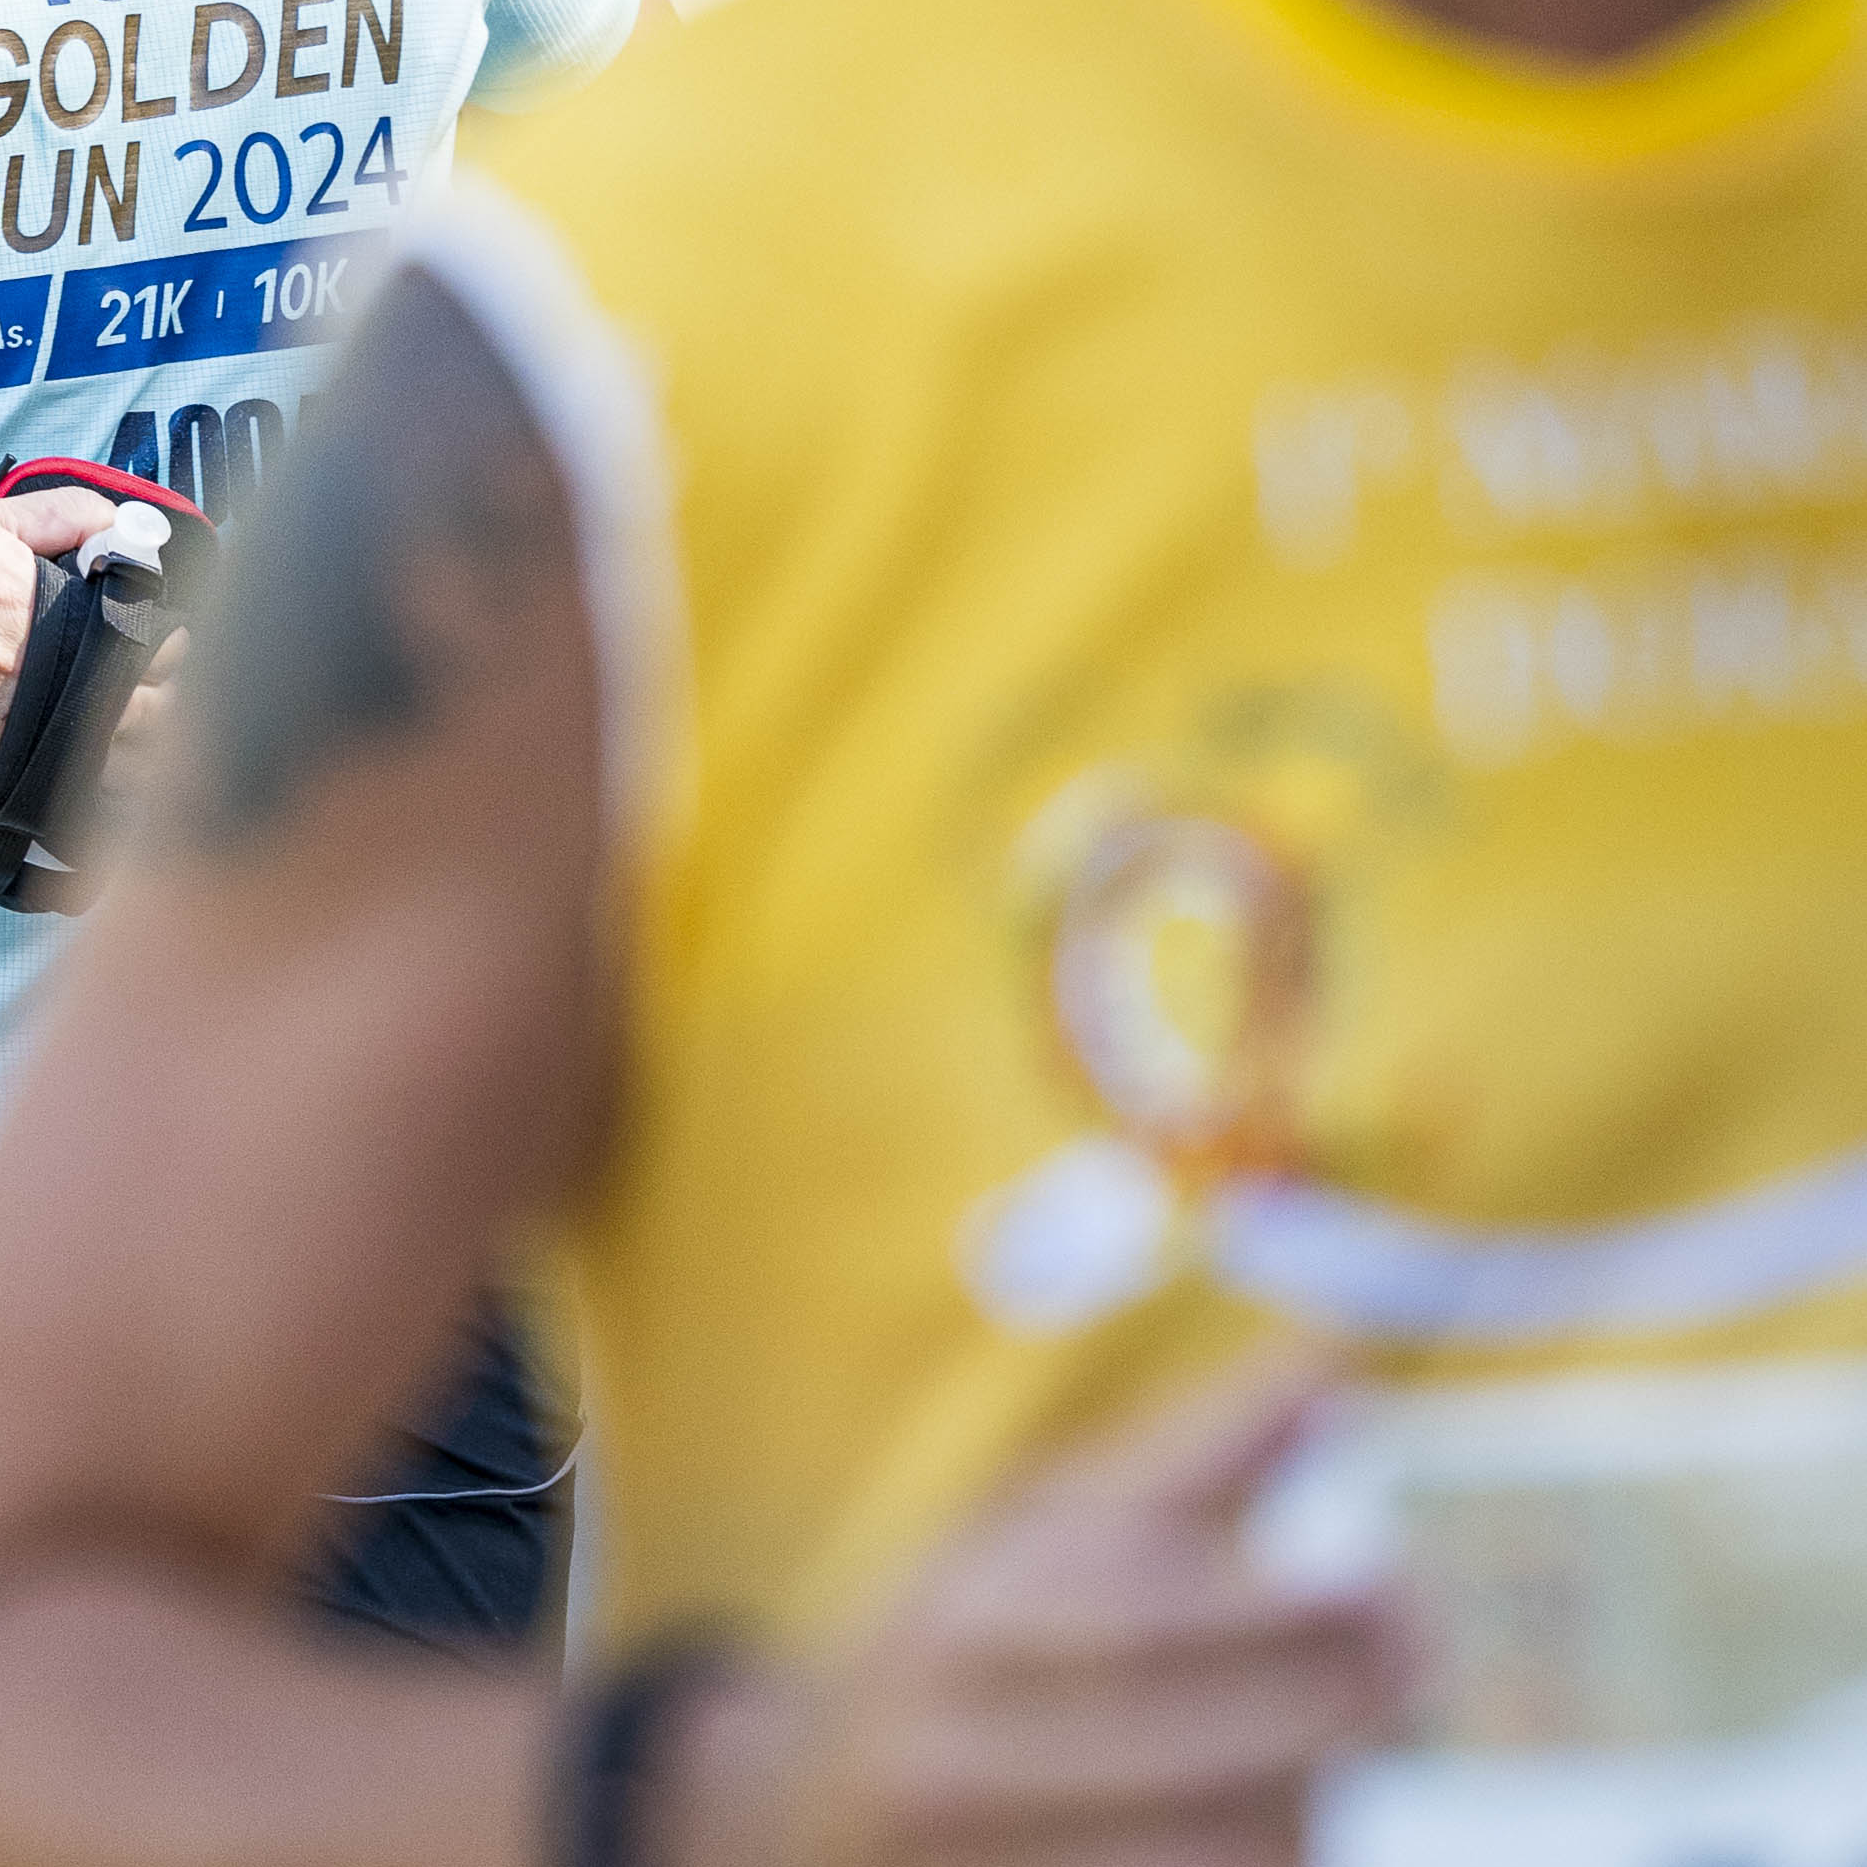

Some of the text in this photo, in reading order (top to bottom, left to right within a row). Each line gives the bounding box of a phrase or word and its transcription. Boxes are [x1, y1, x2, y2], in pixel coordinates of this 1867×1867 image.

[173, 115, 409, 234] 2024
[95, 278, 195, 348] 21K
[252, 257, 350, 325] 10K
